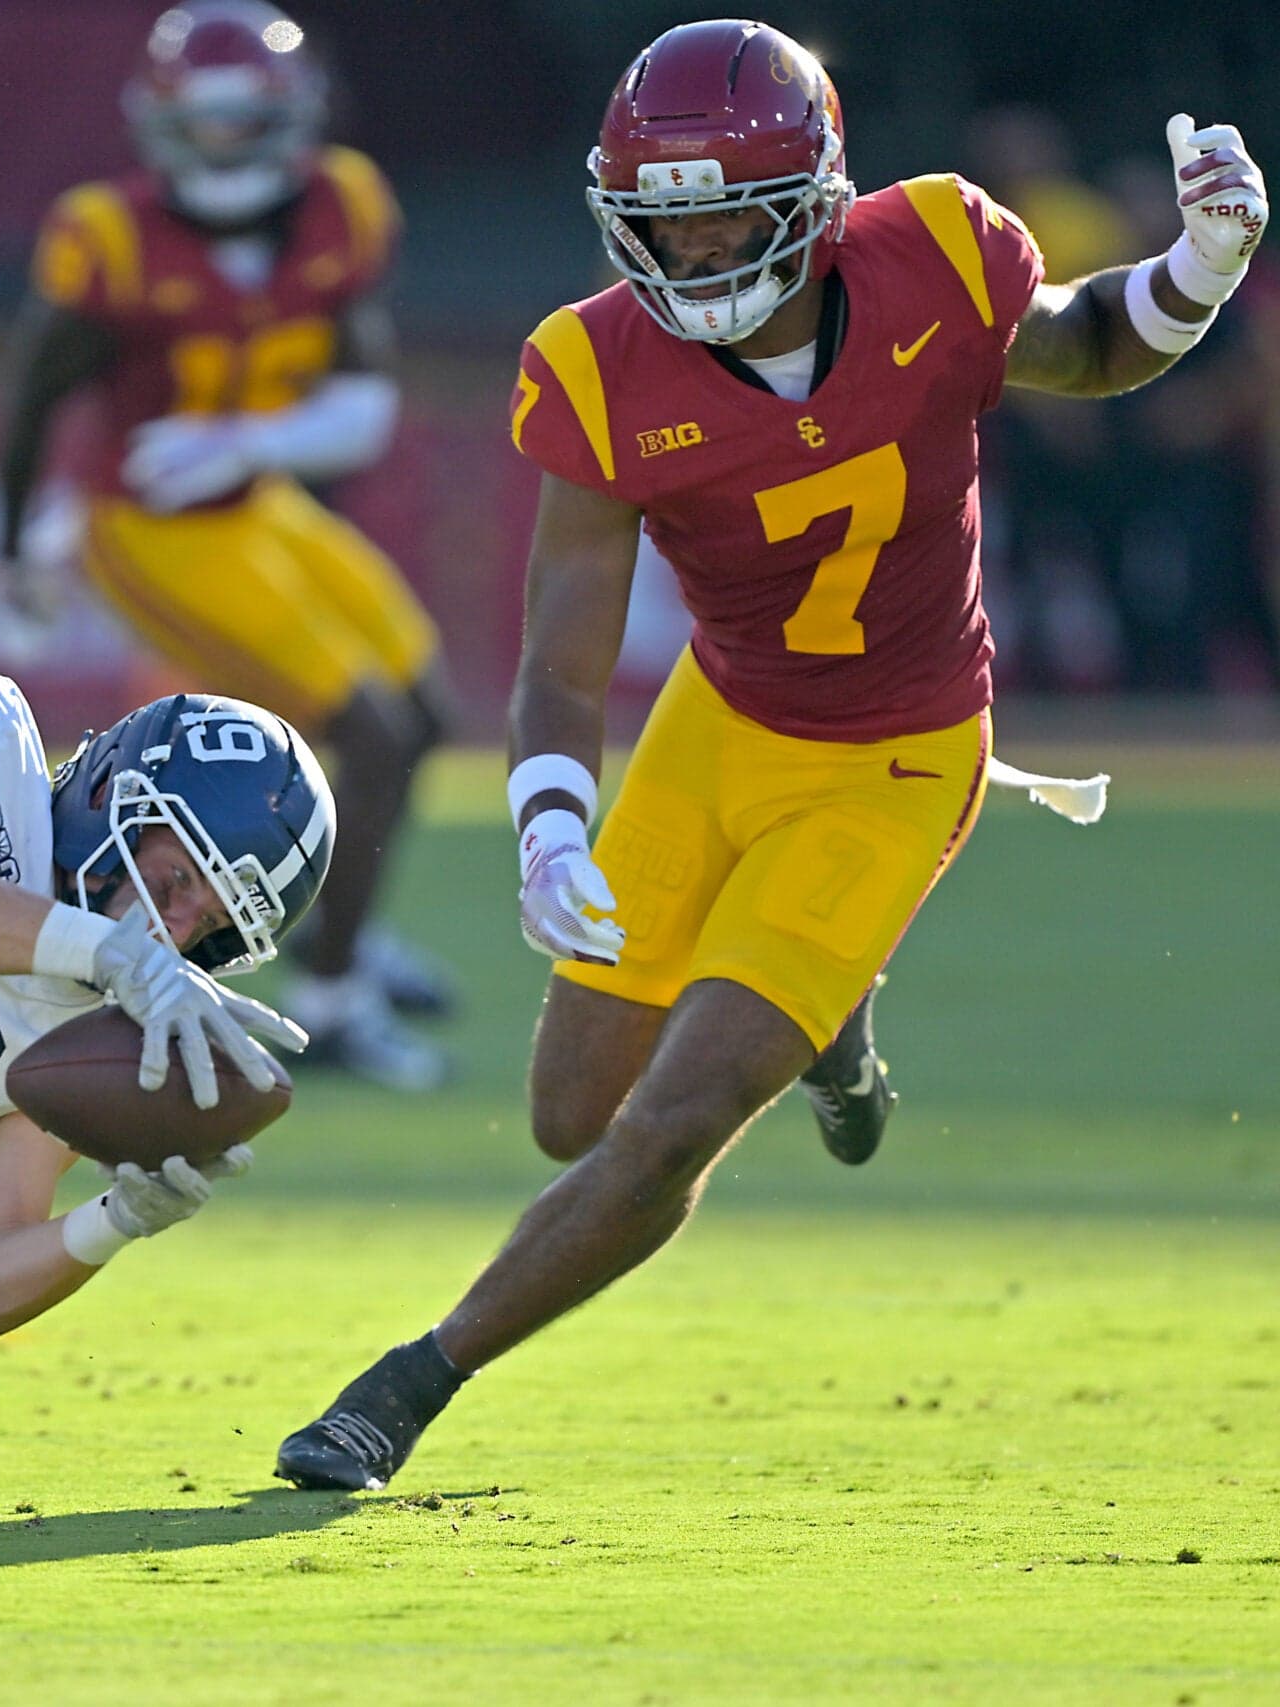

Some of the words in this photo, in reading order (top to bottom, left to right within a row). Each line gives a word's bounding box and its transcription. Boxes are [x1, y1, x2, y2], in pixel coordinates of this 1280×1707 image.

[614, 222, 658, 274] TROJANS
[797, 416, 826, 448] SC
[753, 441, 908, 655] 7
[180, 711, 267, 762] 19
